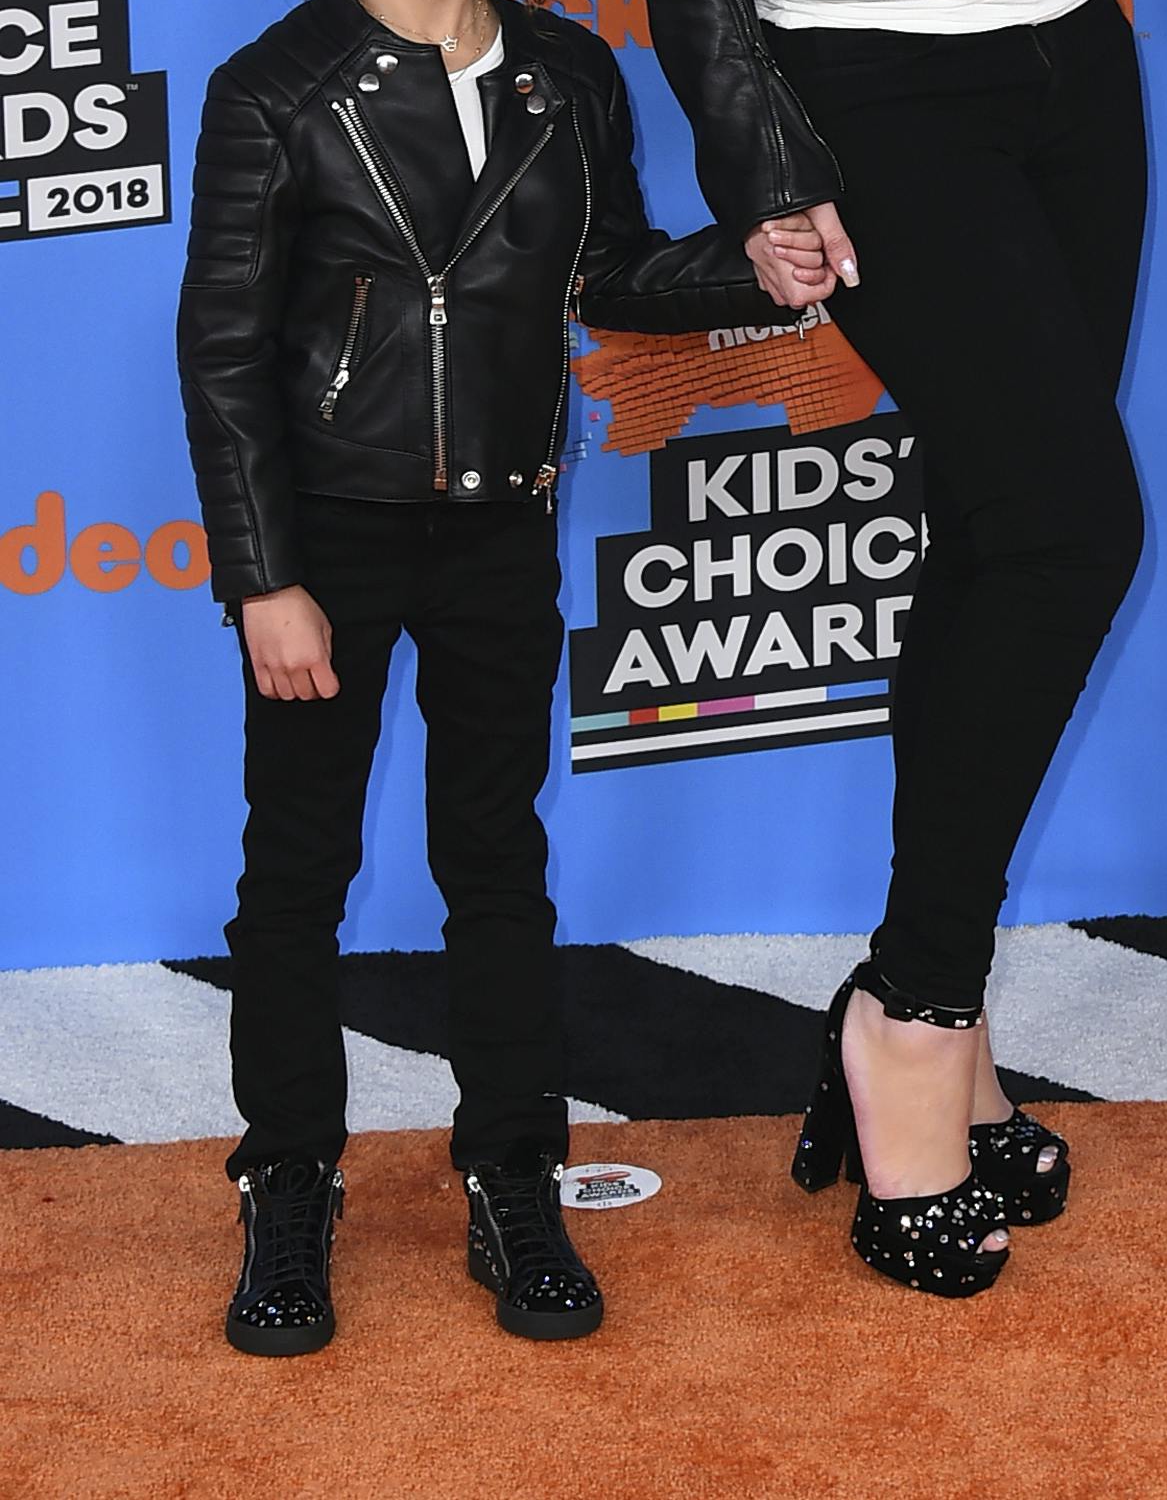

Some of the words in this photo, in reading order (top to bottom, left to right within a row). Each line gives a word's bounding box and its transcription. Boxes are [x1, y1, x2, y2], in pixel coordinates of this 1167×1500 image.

[0, 83, 129, 161] DS
[46, 177, 150, 219] 2018
[687, 436, 917, 524] KIDS'
[623, 511, 931, 609] CHOIC
